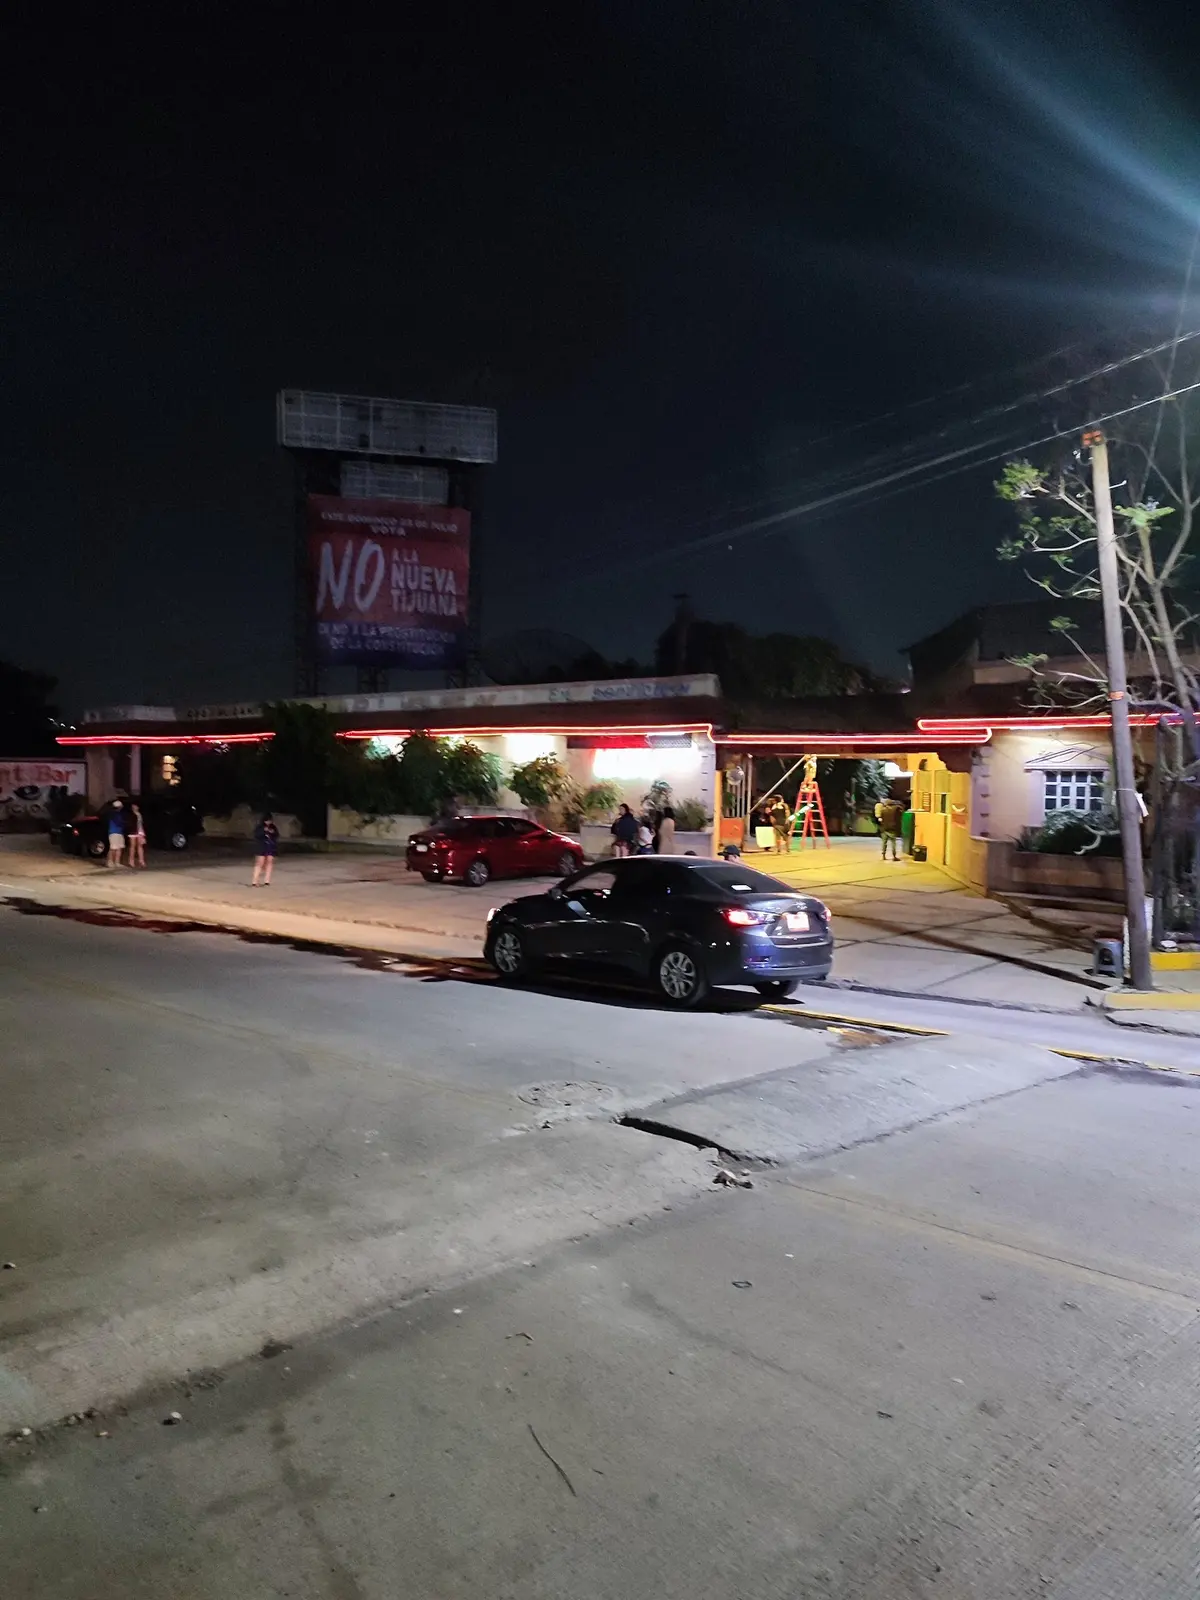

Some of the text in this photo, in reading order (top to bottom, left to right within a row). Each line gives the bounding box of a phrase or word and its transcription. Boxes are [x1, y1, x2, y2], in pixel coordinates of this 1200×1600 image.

[370, 525, 406, 536] VOTA
[392, 547, 419, 562] A LA
[316, 539, 385, 614] NO
[390, 563, 457, 595] NUEVA
[390, 588, 458, 616] TIJUANA
[35, 765, 77, 782] Bar
